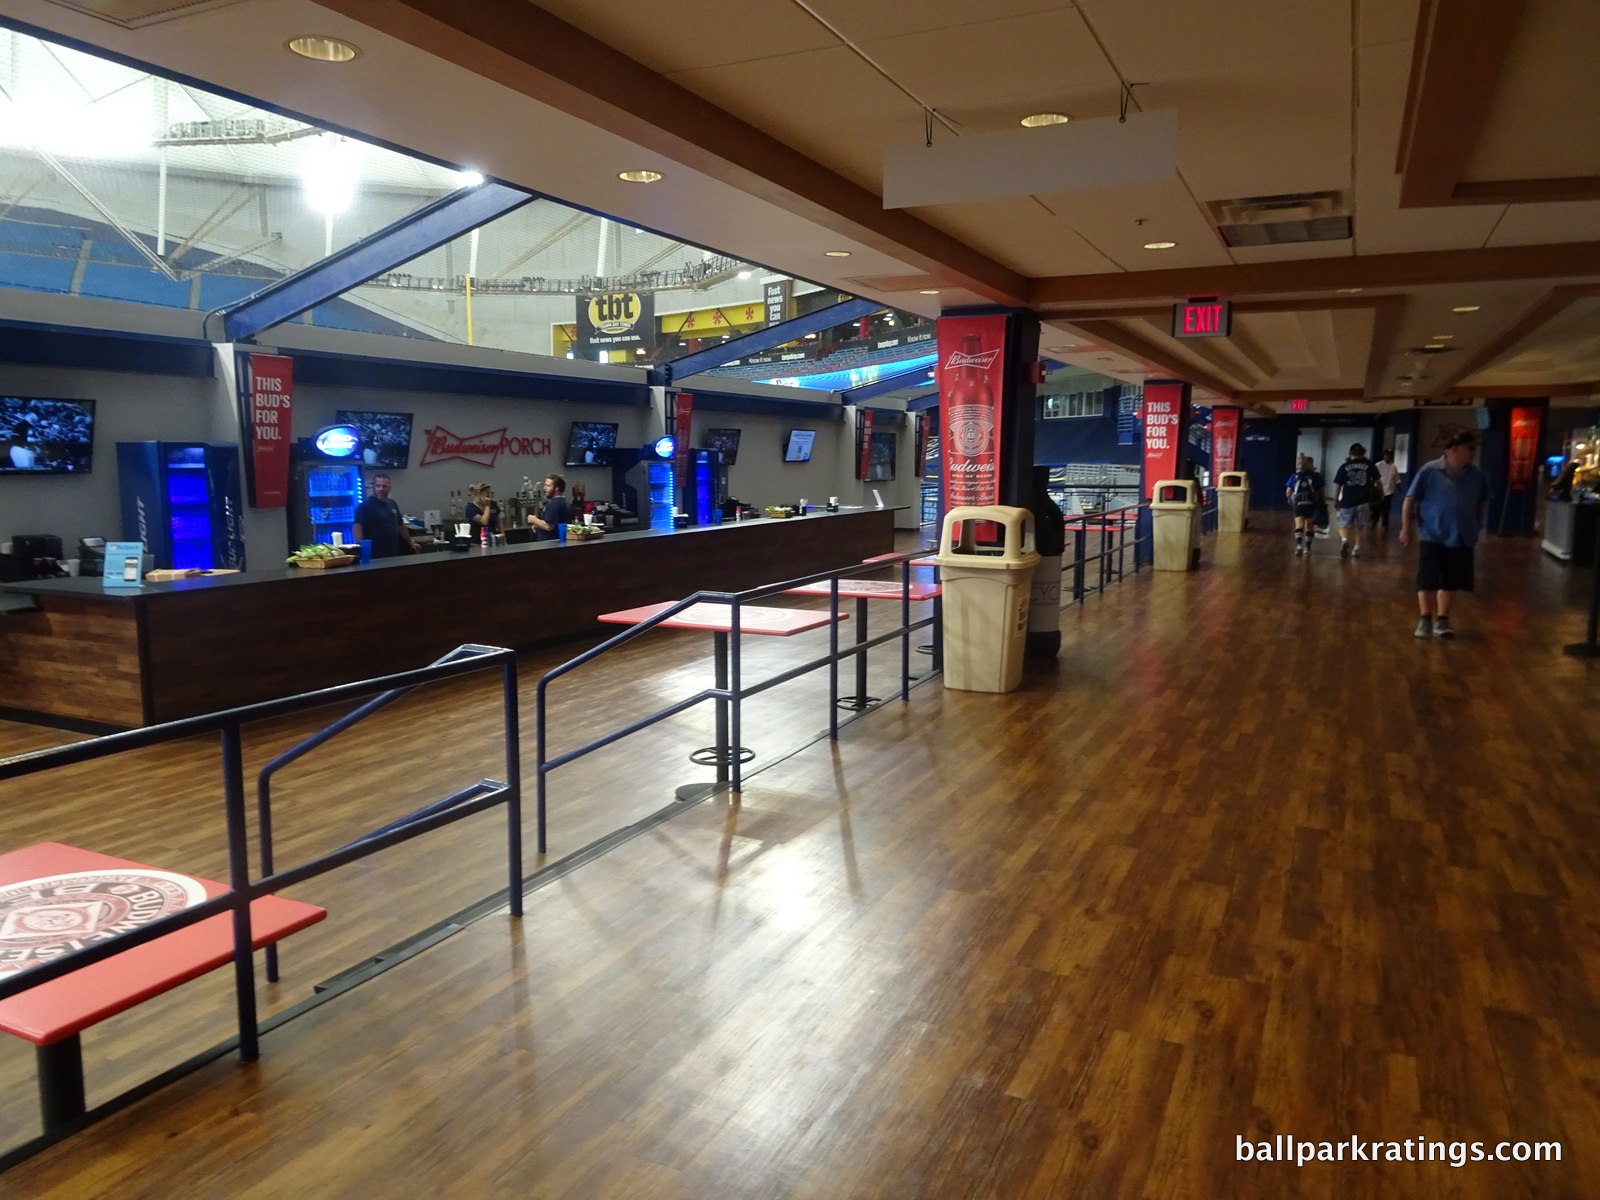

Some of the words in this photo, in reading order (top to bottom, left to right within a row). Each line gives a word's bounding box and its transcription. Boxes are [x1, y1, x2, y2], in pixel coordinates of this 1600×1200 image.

[767, 286, 781, 296] Fast
[767, 296, 783, 305] news
[595, 293, 634, 321] tbt
[769, 305, 781, 315] you
[769, 313, 781, 321] can
[1183, 305, 1222, 333] EXIT
[949, 355, 995, 365] Budweiser
[255, 376, 282, 392] THIS
[255, 393, 291, 409] BUD'S
[1146, 401, 1171, 413] THIS
[1290, 399, 1308, 411] EXIT
[255, 410, 278, 424] FOR
[1146, 414, 1179, 425] BUD'S
[255, 426, 282, 440] YOU.
[1146, 426, 1167, 437] FOR
[429, 436, 500, 455] Budweiser
[499, 437, 552, 456] PORCH
[1145, 438, 1171, 449] YOU.
[0, 889, 164, 963] BUDWEISE
